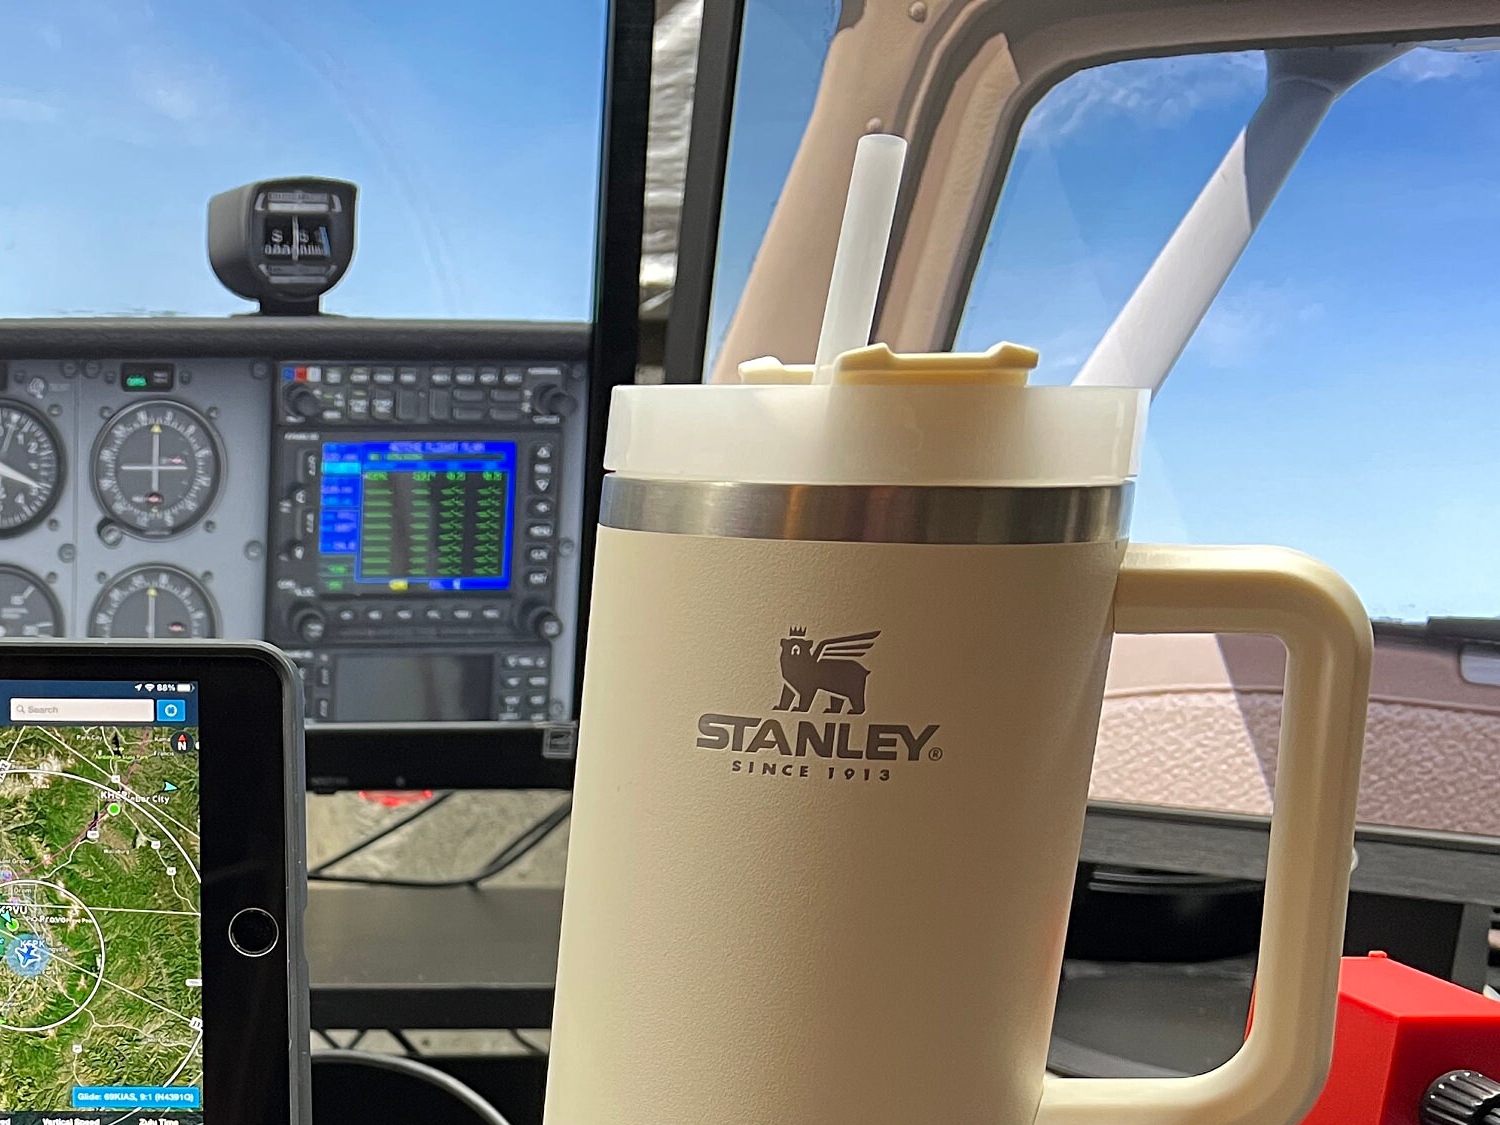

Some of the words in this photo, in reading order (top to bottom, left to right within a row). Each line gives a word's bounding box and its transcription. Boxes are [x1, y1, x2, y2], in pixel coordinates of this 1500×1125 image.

[157, 684, 175, 692] 88%
[27, 704, 58, 715] Search
[696, 713, 941, 762] STANLEY
[178, 742, 187, 750] N
[731, 760, 810, 778] SINCE
[828, 766, 891, 782] 1913
